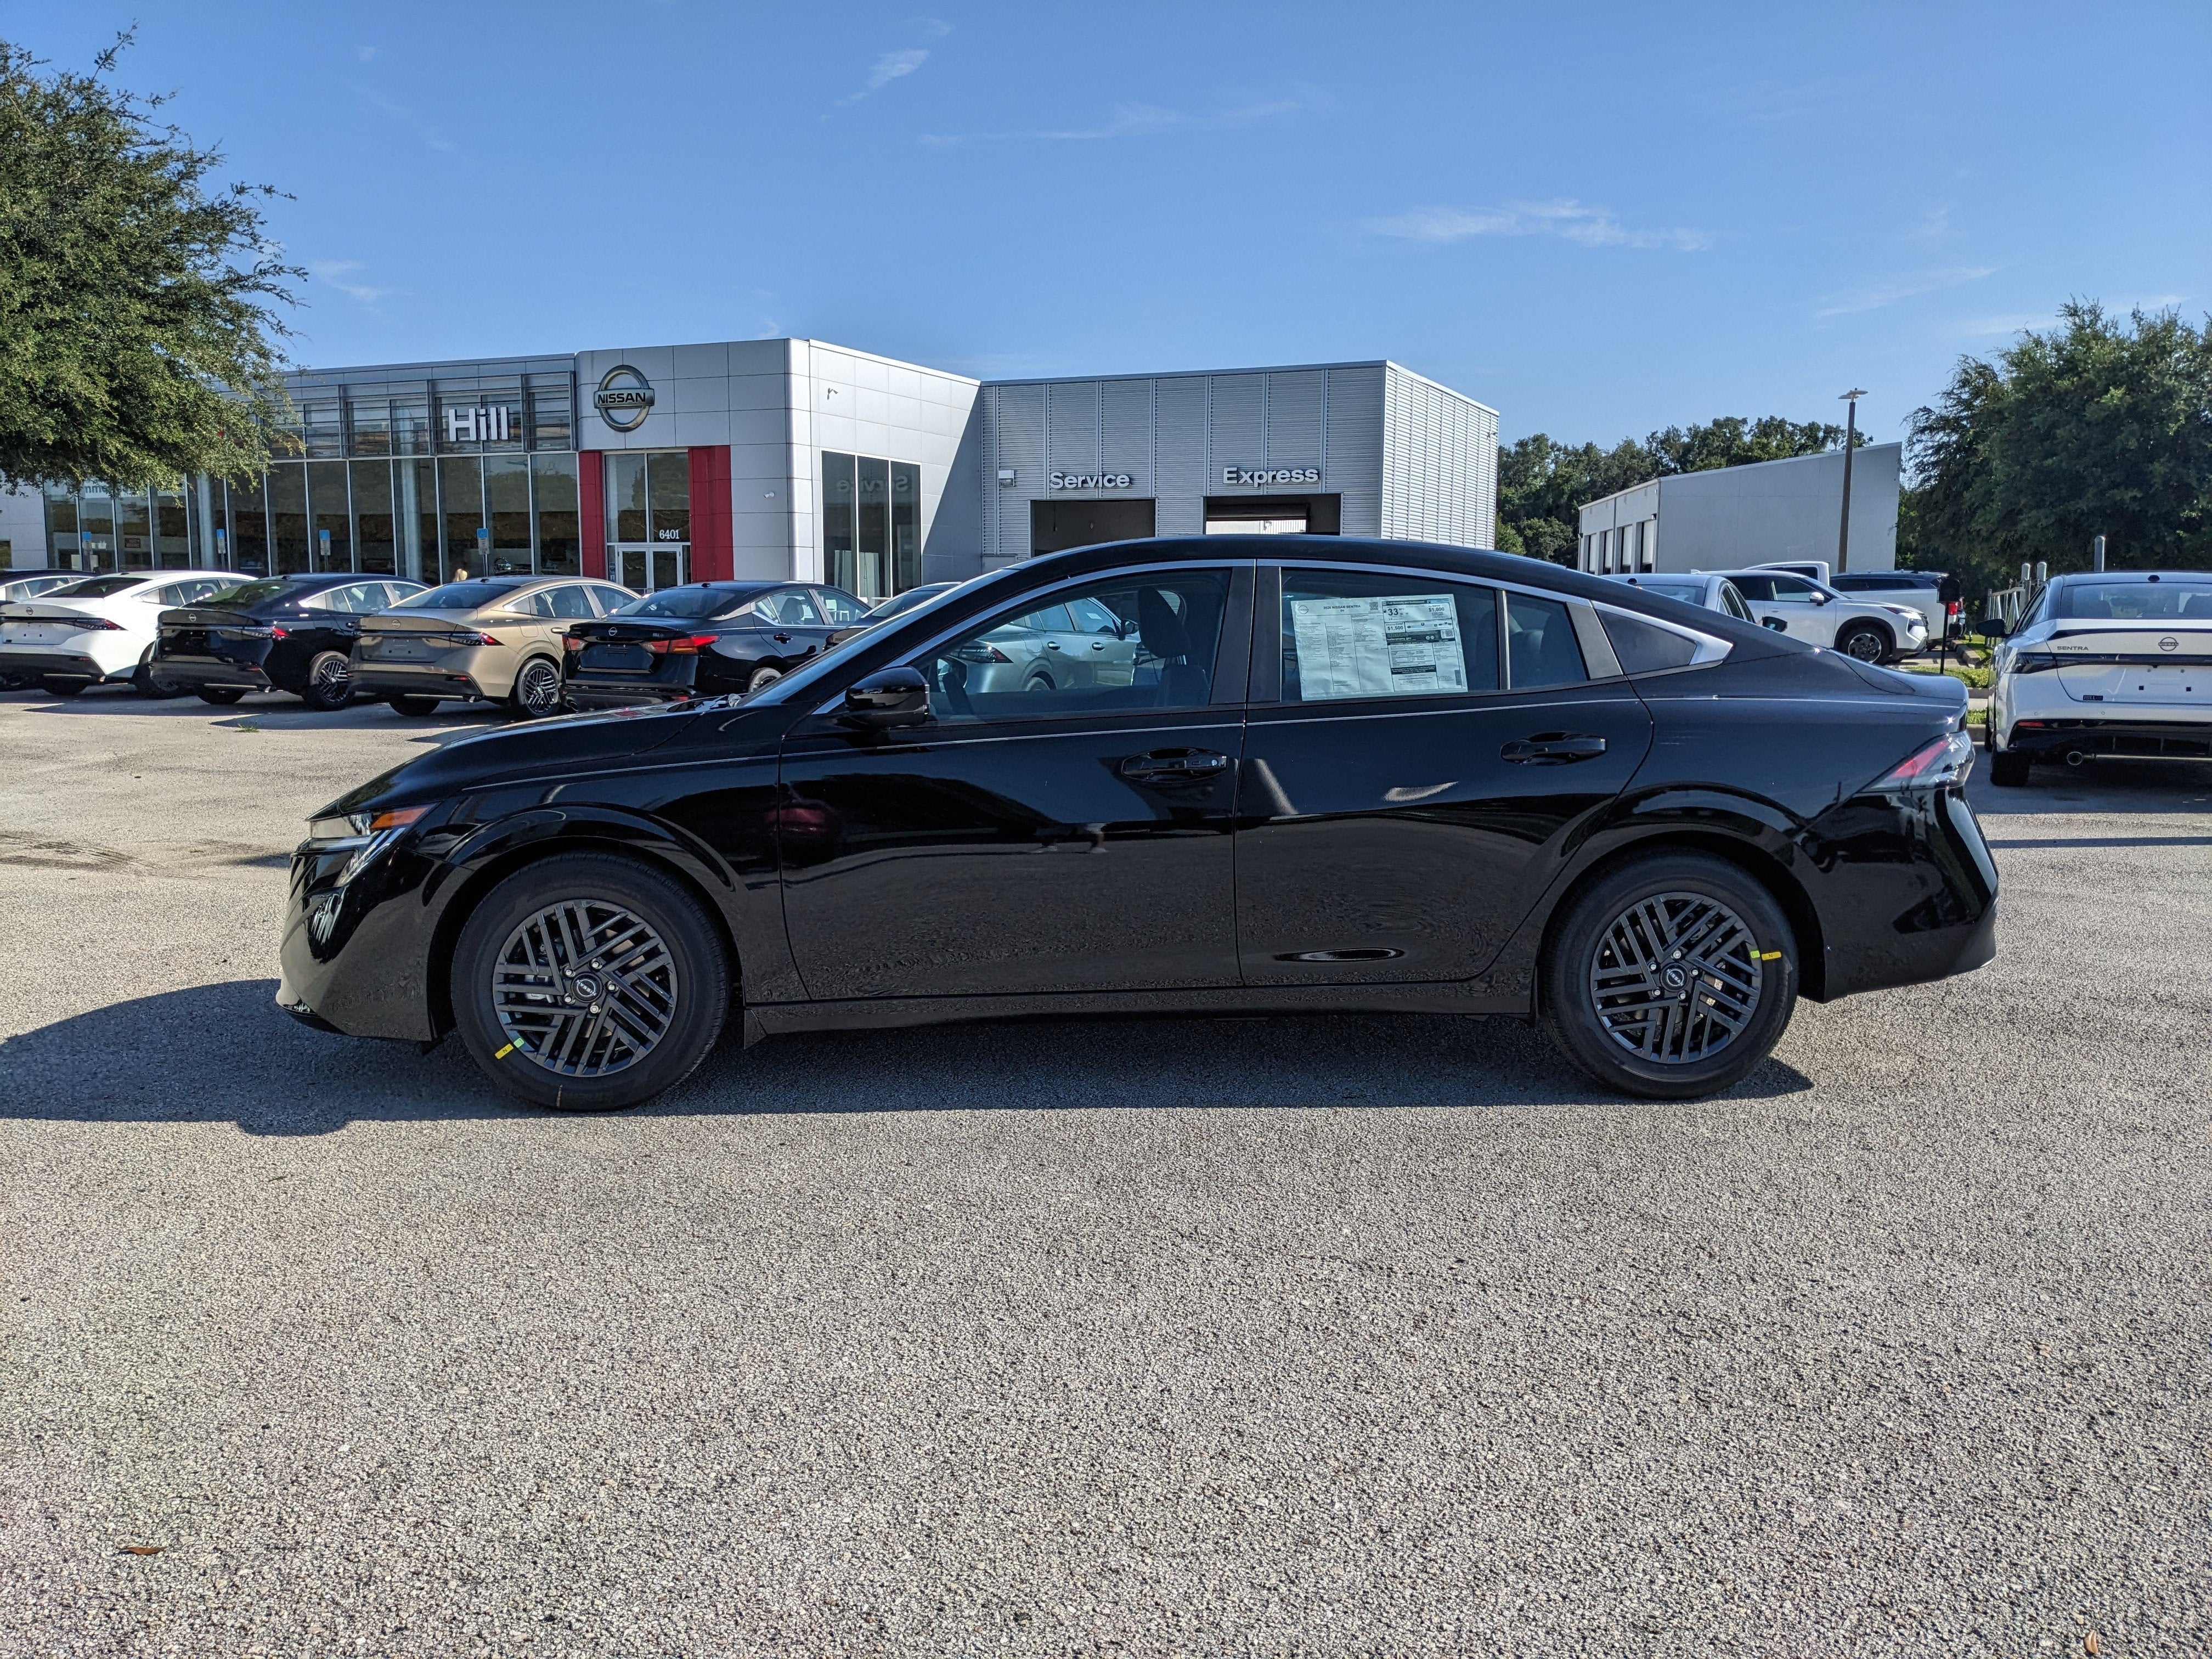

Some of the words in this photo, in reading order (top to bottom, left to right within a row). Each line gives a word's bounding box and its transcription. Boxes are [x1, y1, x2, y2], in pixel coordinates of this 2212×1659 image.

[597, 392, 646, 404] NISSAN
[449, 407, 509, 442] Hill
[1049, 471, 1132, 489] Service
[1223, 467, 1319, 487] Express
[659, 529, 680, 539] 6401
[1387, 608, 1398, 616] 33
[577, 979, 597, 996] NISSAN
